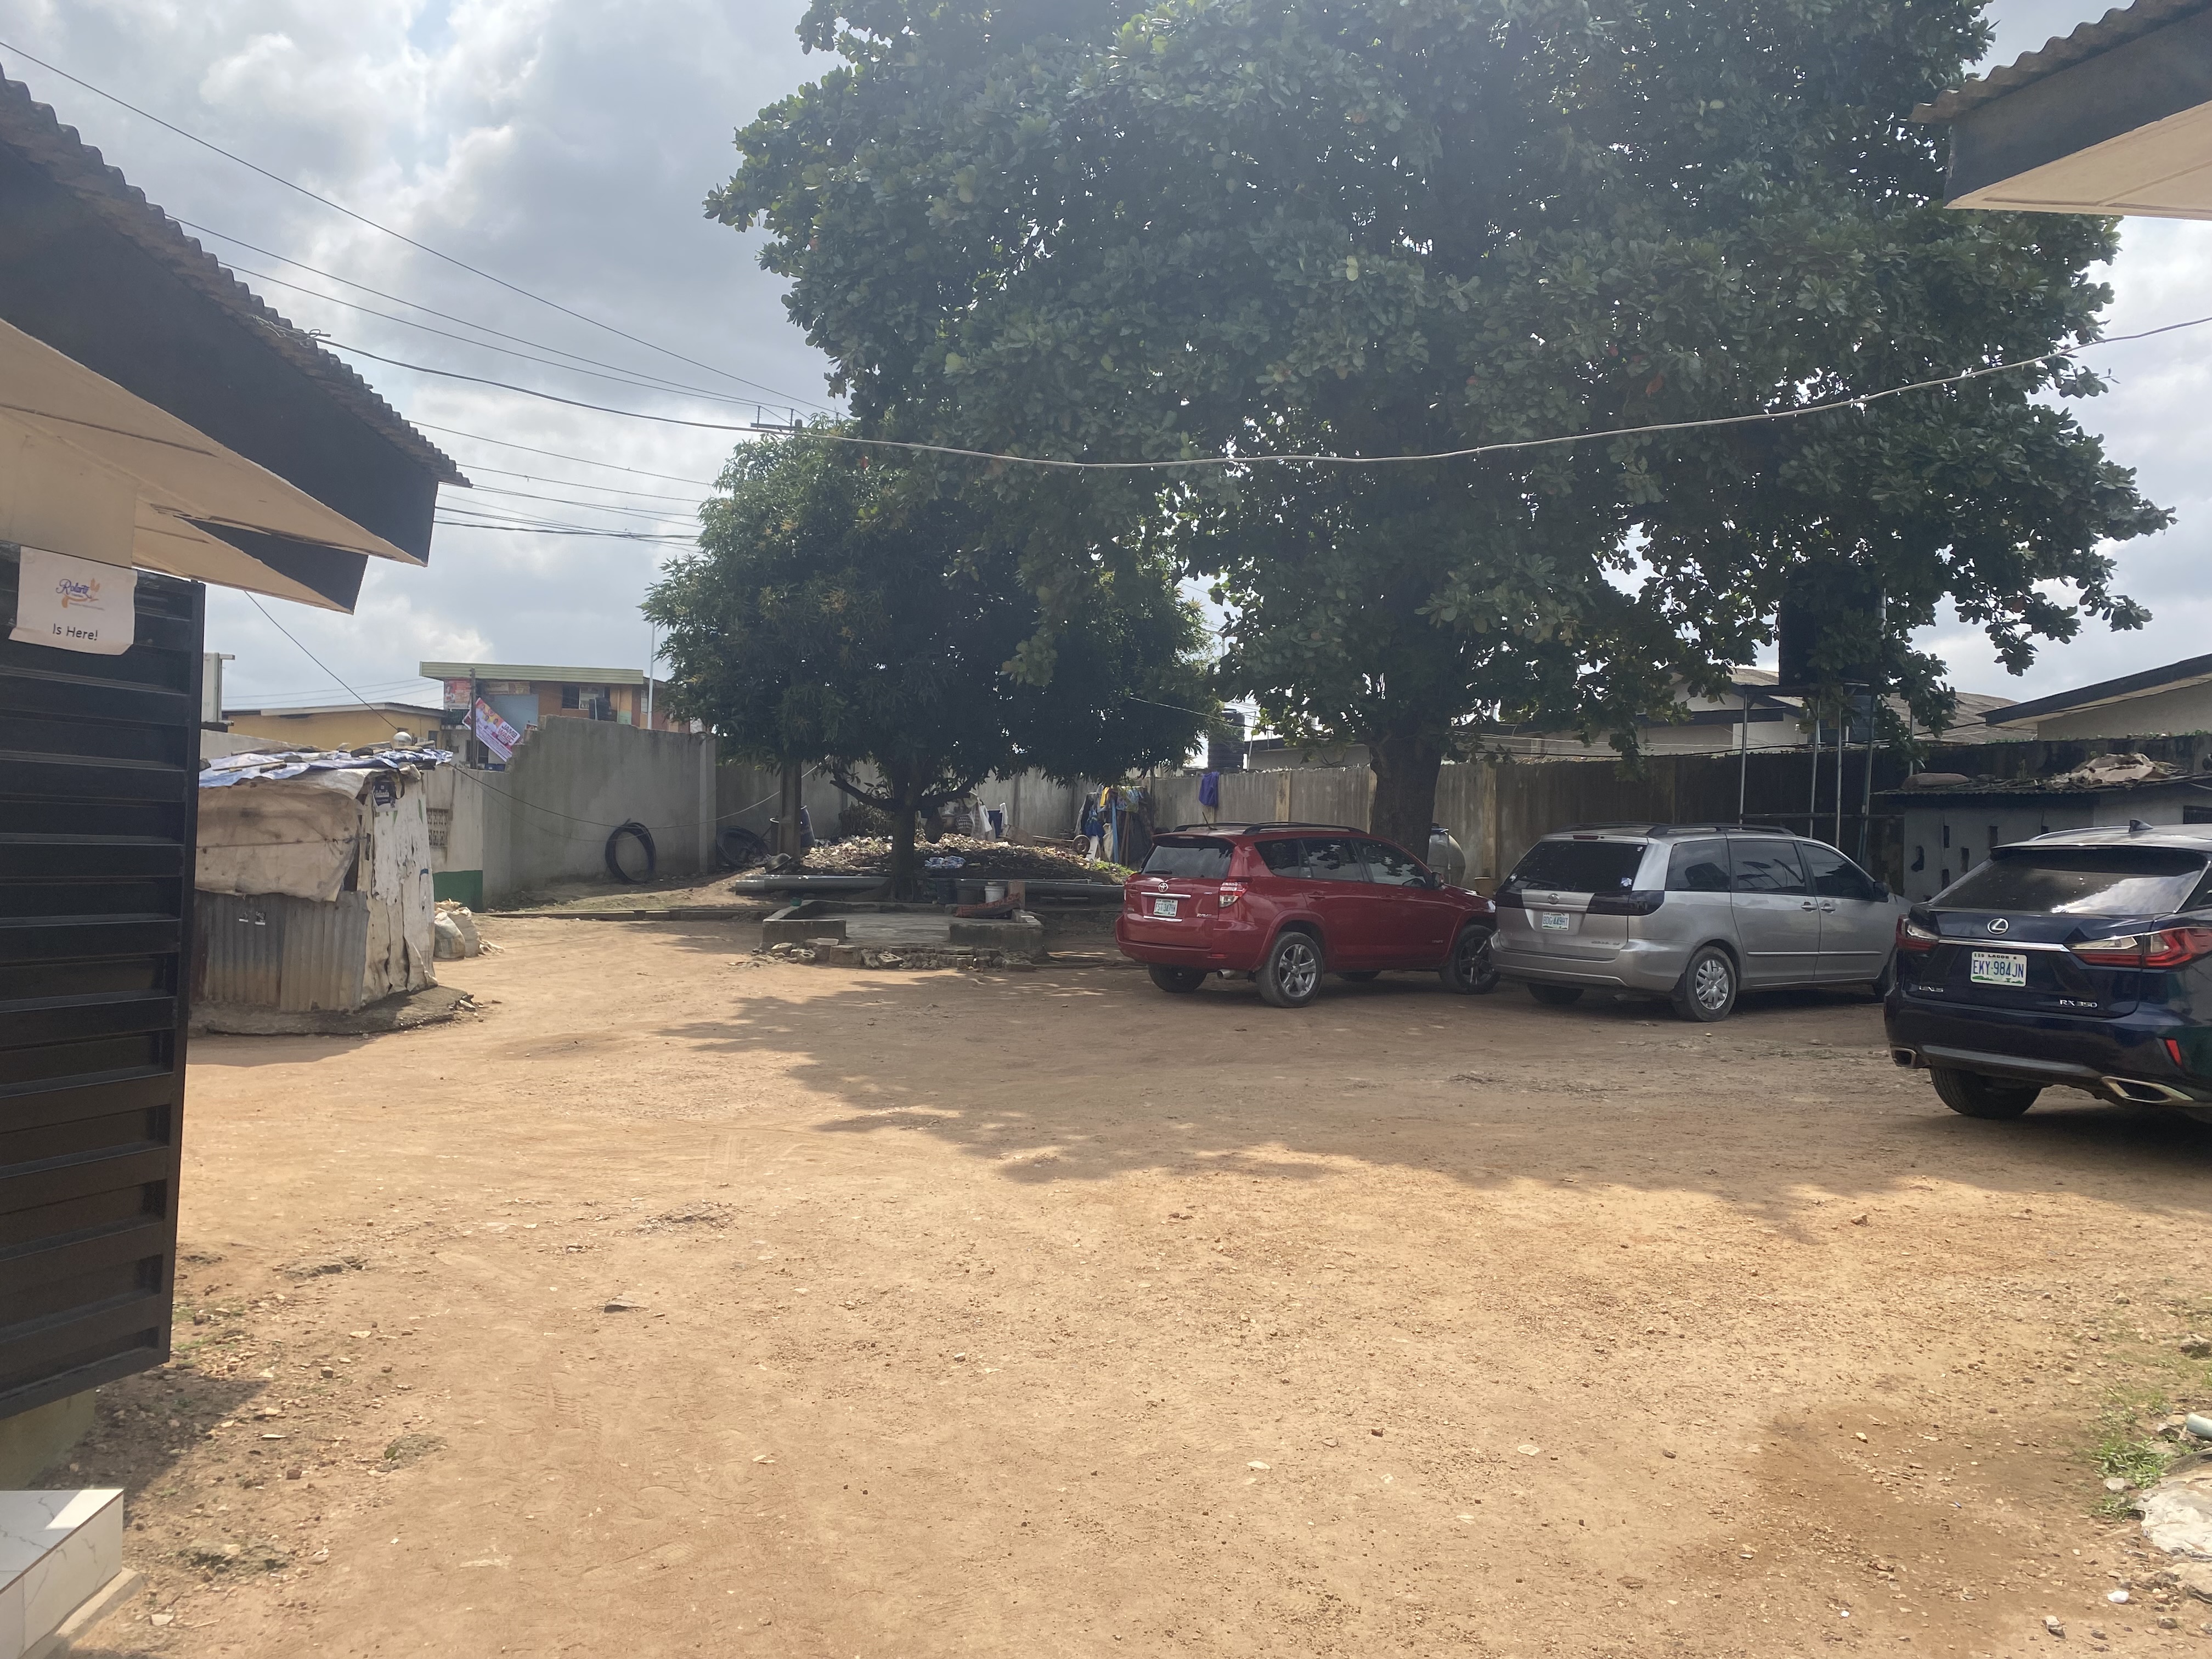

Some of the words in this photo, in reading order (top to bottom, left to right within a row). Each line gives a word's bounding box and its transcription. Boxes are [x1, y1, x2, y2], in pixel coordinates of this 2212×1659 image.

[53, 623, 62, 635] Is
[66, 626, 98, 641] Here!
[498, 728, 514, 744] WAEC
[501, 724, 518, 738] JAMB
[1973, 960, 2024, 978] EKY-984JN
